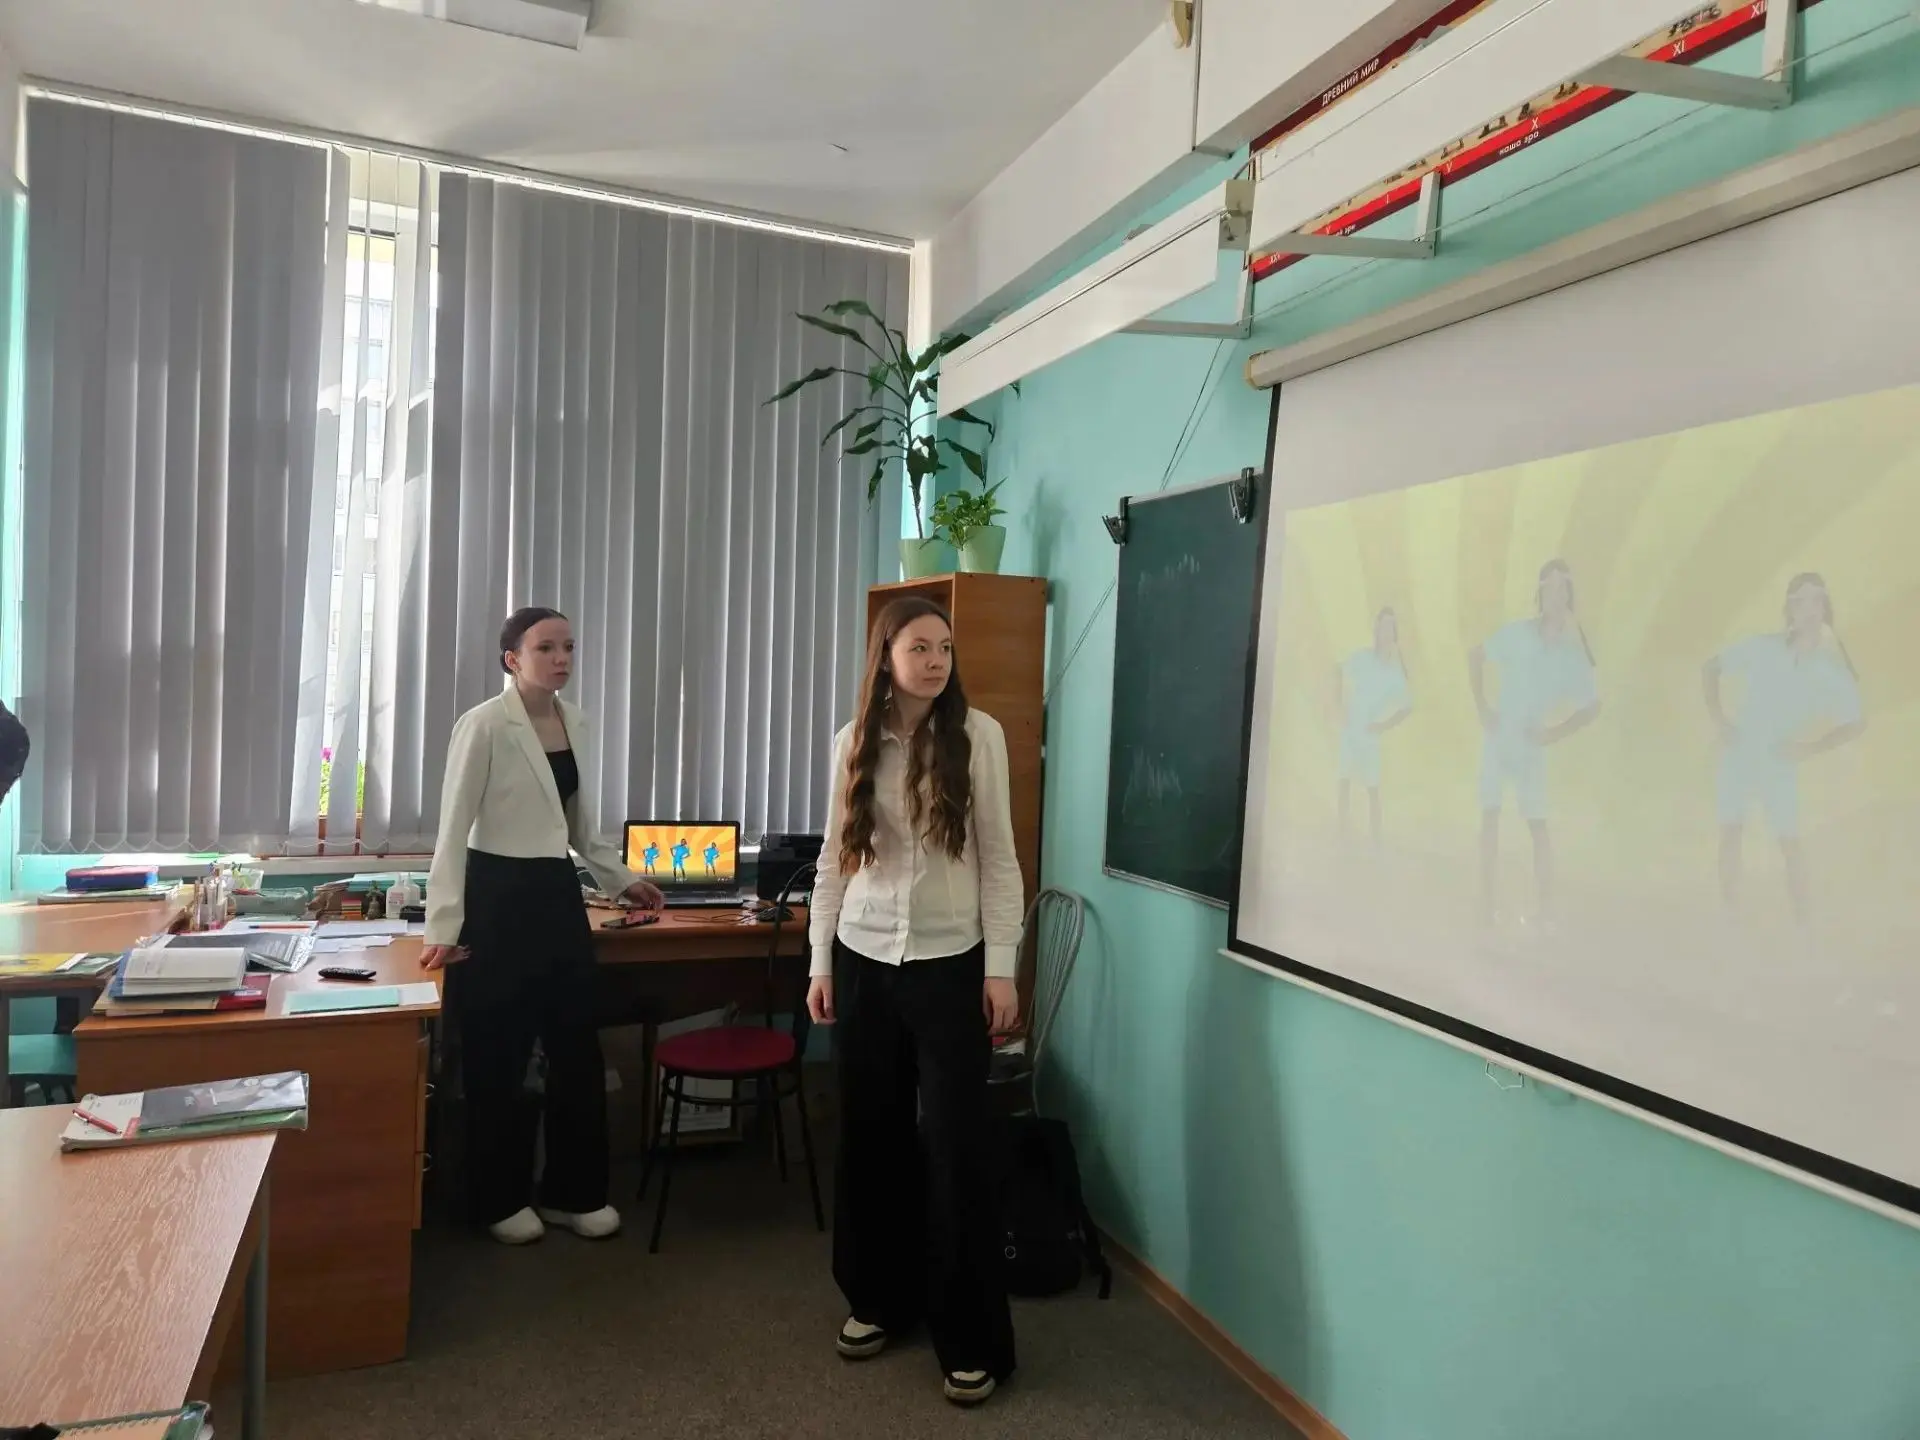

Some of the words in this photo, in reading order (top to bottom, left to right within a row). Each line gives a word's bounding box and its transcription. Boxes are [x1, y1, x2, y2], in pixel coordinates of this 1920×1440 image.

[1673, 40, 1685, 57] XI
[1322, 70, 1359, 107] ДРЕВНИЙ
[1360, 58, 1379, 79] МИР
[1531, 116, 1539, 131] X
